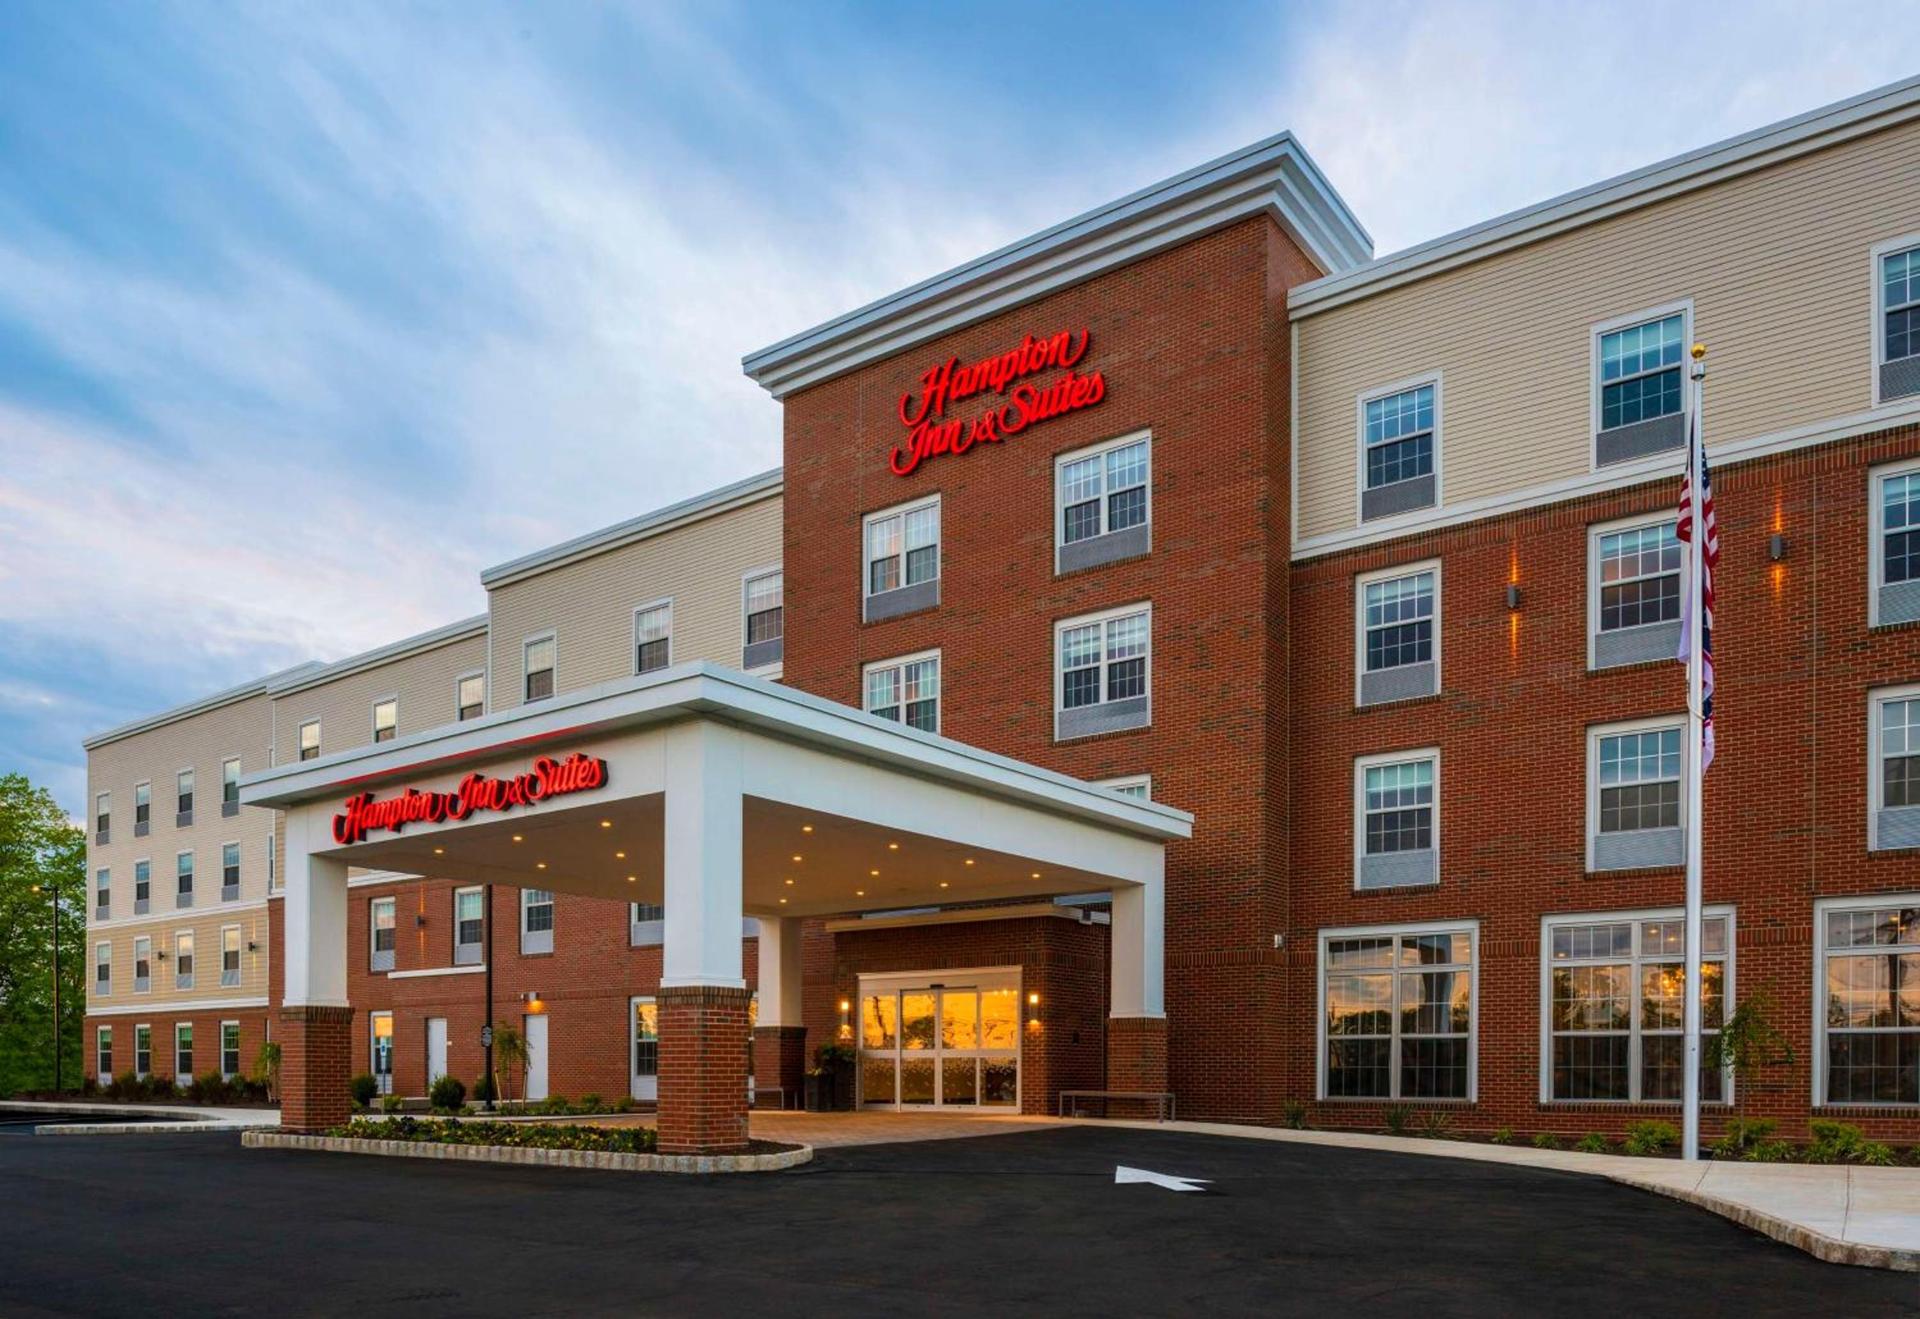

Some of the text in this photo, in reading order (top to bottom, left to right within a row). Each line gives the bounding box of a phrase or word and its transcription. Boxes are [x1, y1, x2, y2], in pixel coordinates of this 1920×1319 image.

[890, 371, 1105, 476] Inn & Suites
[901, 328, 1089, 426] Hampton
[332, 753, 607, 844] Hampton Inn & Suites
